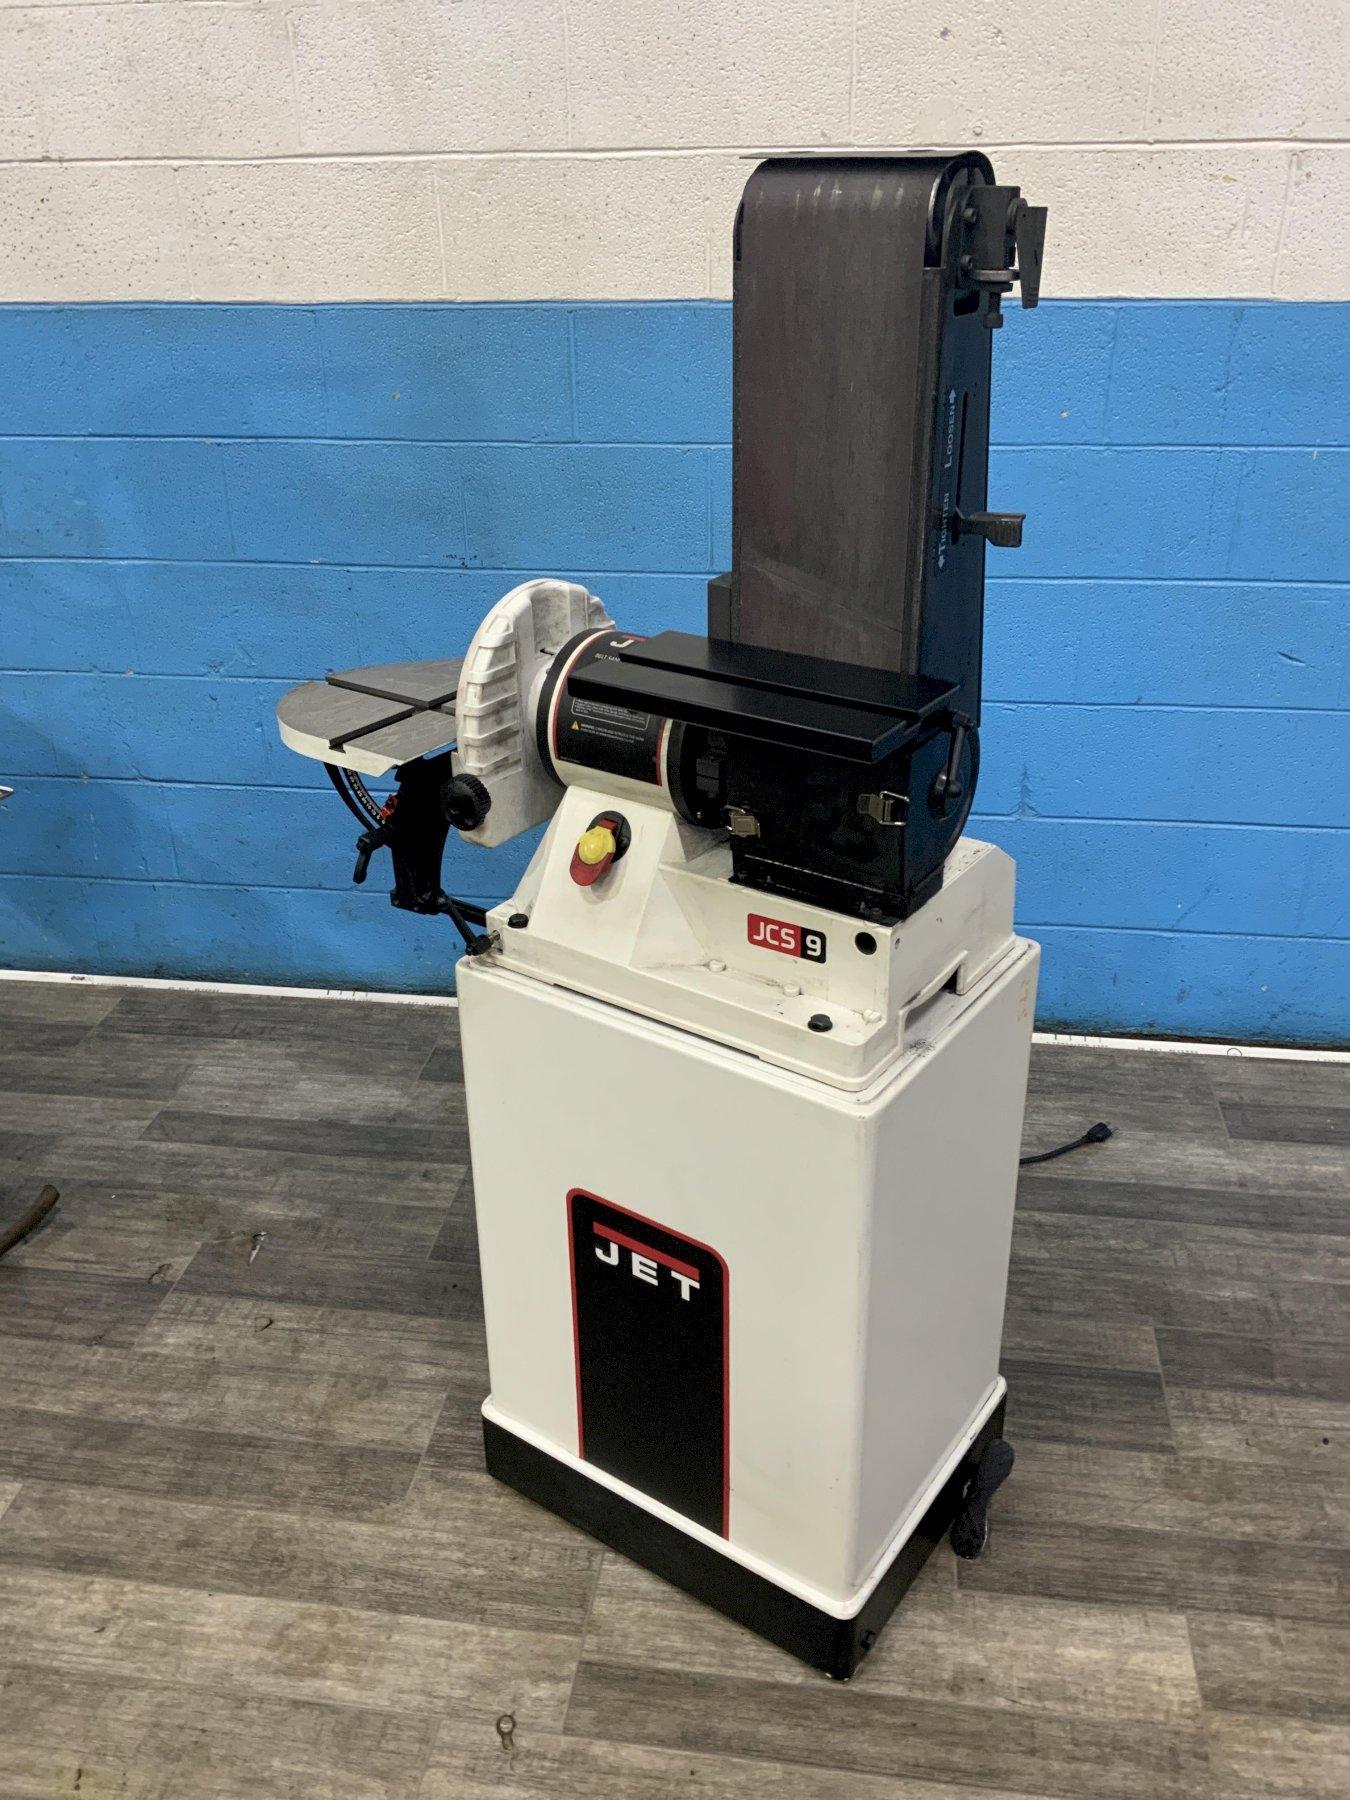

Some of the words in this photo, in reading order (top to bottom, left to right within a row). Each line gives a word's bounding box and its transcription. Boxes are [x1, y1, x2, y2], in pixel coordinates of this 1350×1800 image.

[944, 405, 955, 468] LOOSEN
[938, 493, 949, 555] TIGHTEN
[753, 922, 795, 949] JCS
[806, 934, 821, 957] 9
[595, 1242, 700, 1301] JET
